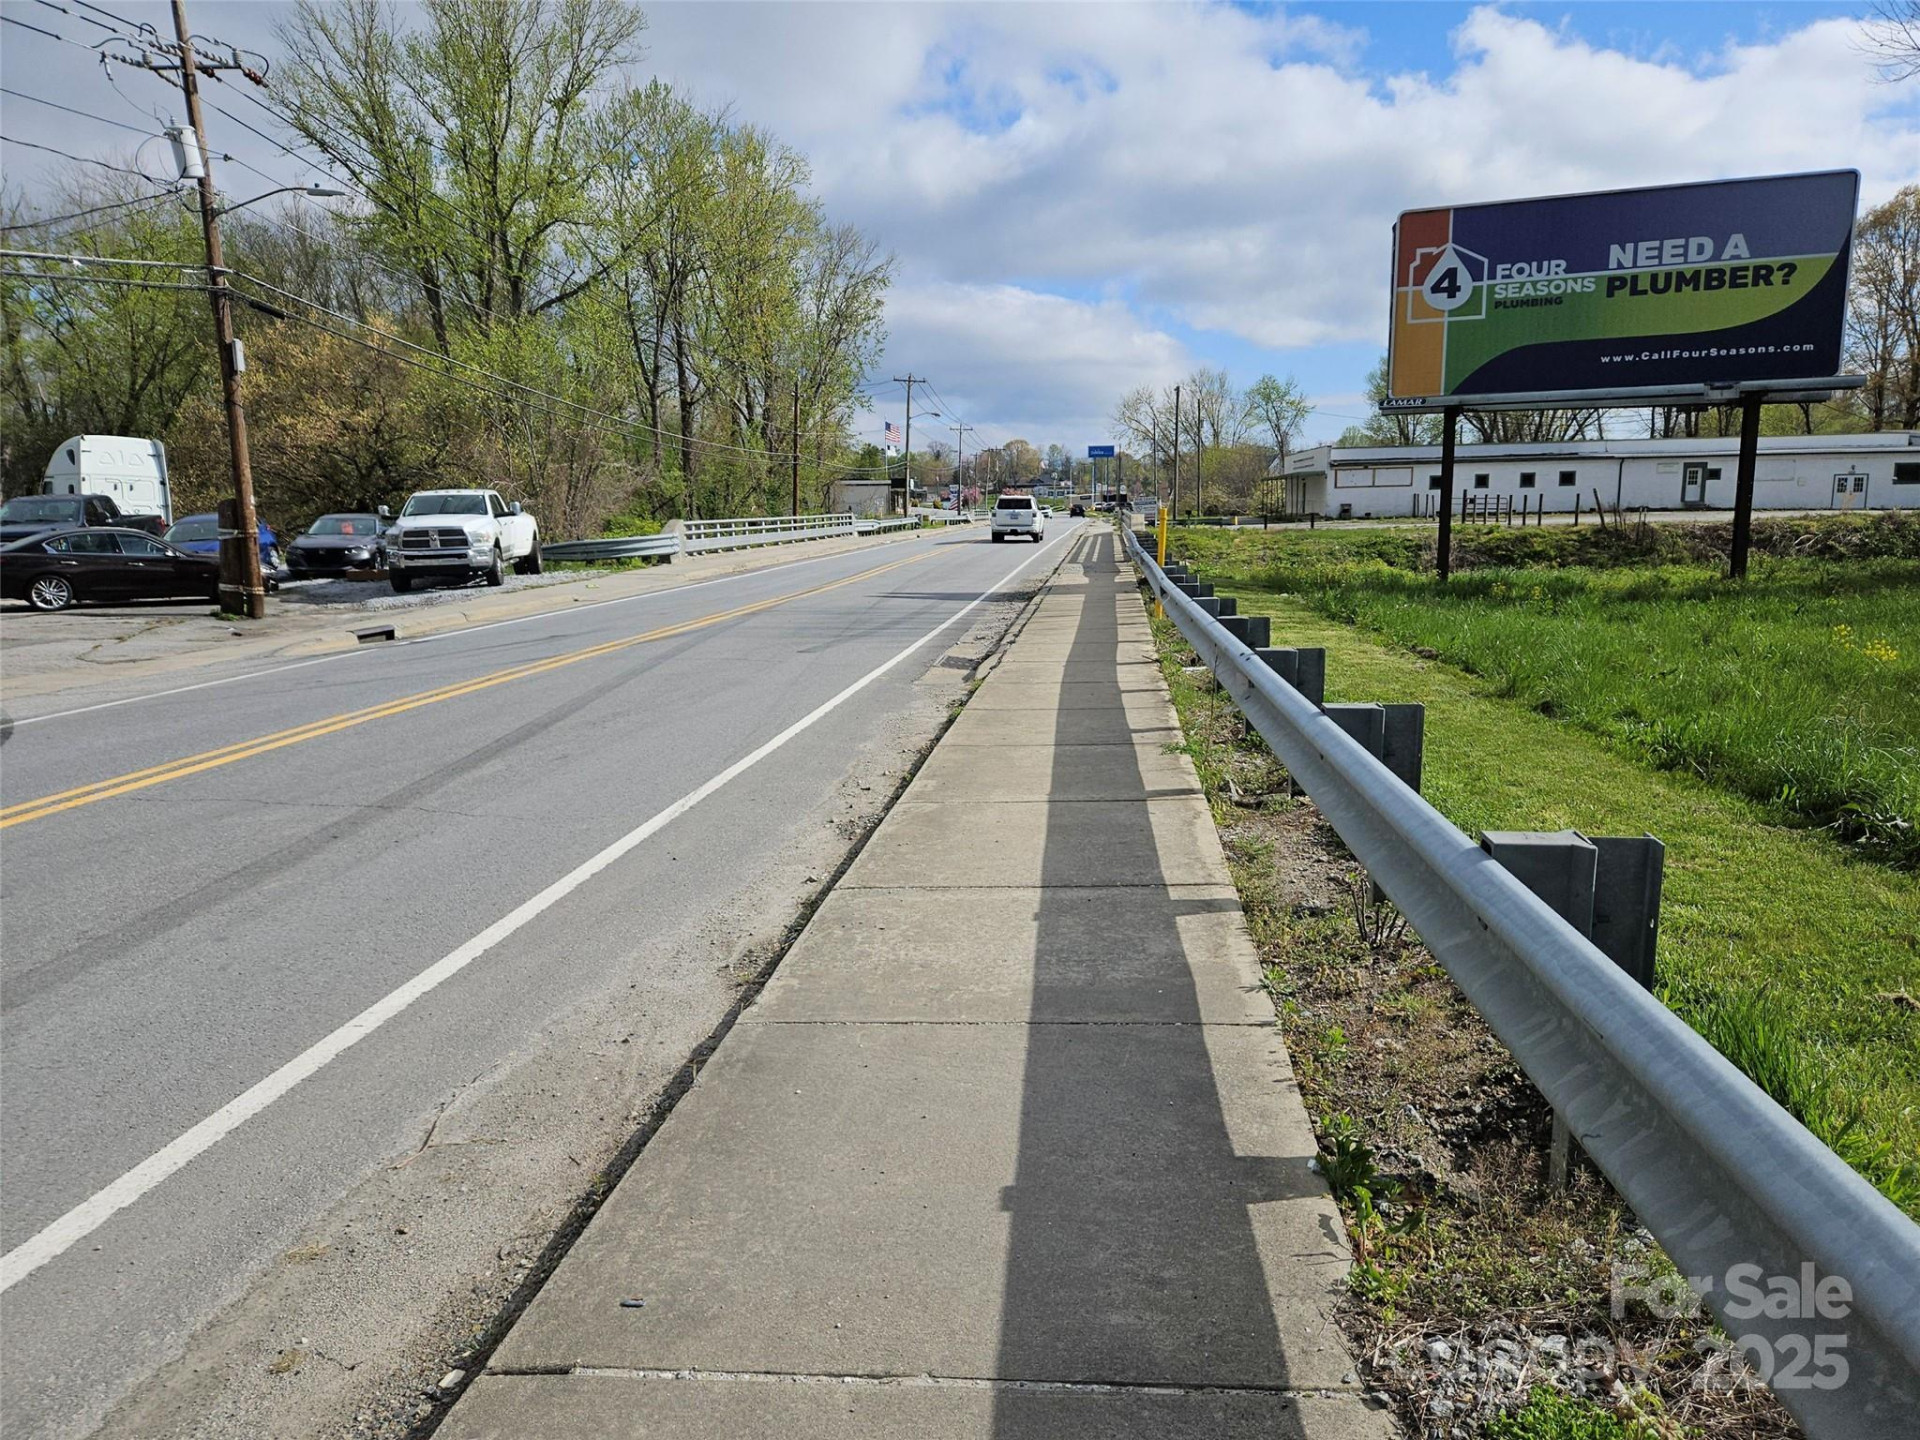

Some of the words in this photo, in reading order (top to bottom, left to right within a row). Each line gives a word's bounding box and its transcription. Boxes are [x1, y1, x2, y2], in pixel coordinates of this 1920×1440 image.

[1609, 236, 1714, 269] NEED
[1721, 233, 1750, 260] A
[1496, 260, 1567, 280] FOUR
[1606, 262, 1797, 298] PLUMBER?
[1430, 267, 1461, 298] 4
[1494, 278, 1596, 299] SEASONS
[1494, 296, 1564, 309] PLUMBING
[1601, 343, 1814, 363] www.CallFourSeasons.com
[1383, 398, 1422, 406] LAMAR
